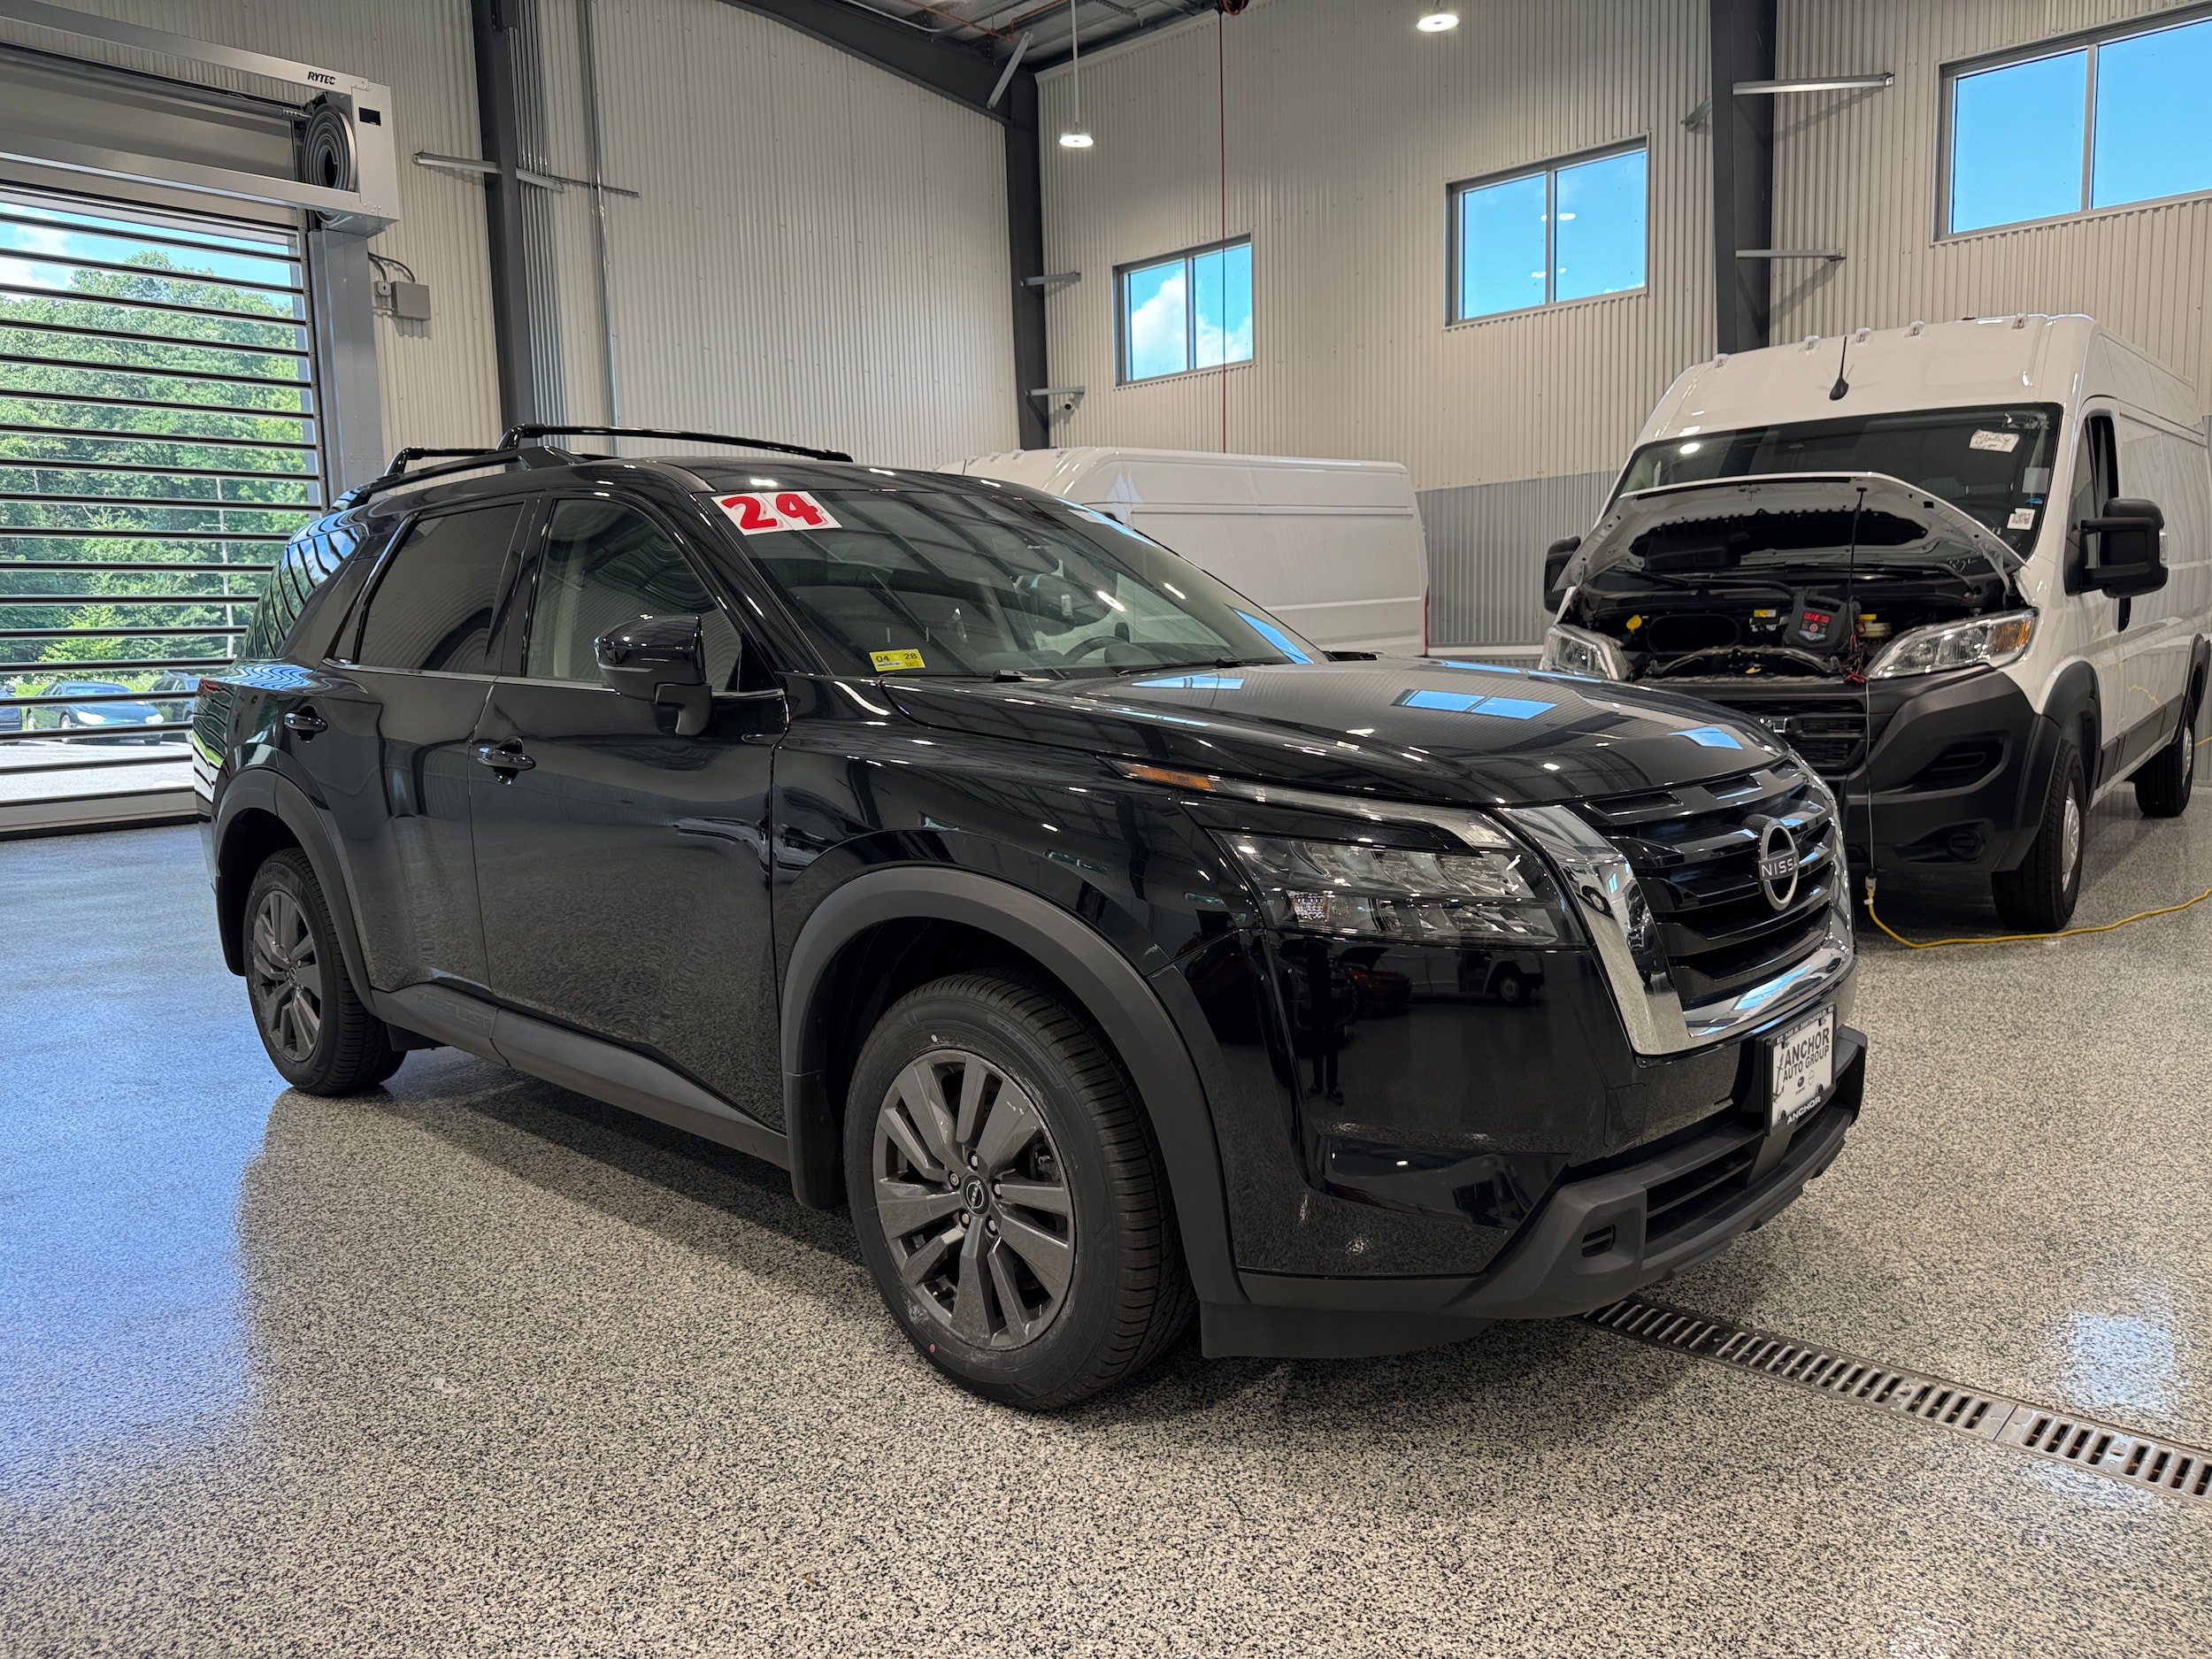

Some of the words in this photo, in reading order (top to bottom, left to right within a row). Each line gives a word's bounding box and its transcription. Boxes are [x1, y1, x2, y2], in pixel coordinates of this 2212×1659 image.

[307, 71, 336, 85] RYTEC
[720, 493, 829, 530] 24
[1783, 1061, 1803, 1082] AUTO
[1805, 1045, 1830, 1068] GROUP
[1785, 1027, 1830, 1069] ANCHOR
[1786, 1096, 1821, 1125] ANCHOR
